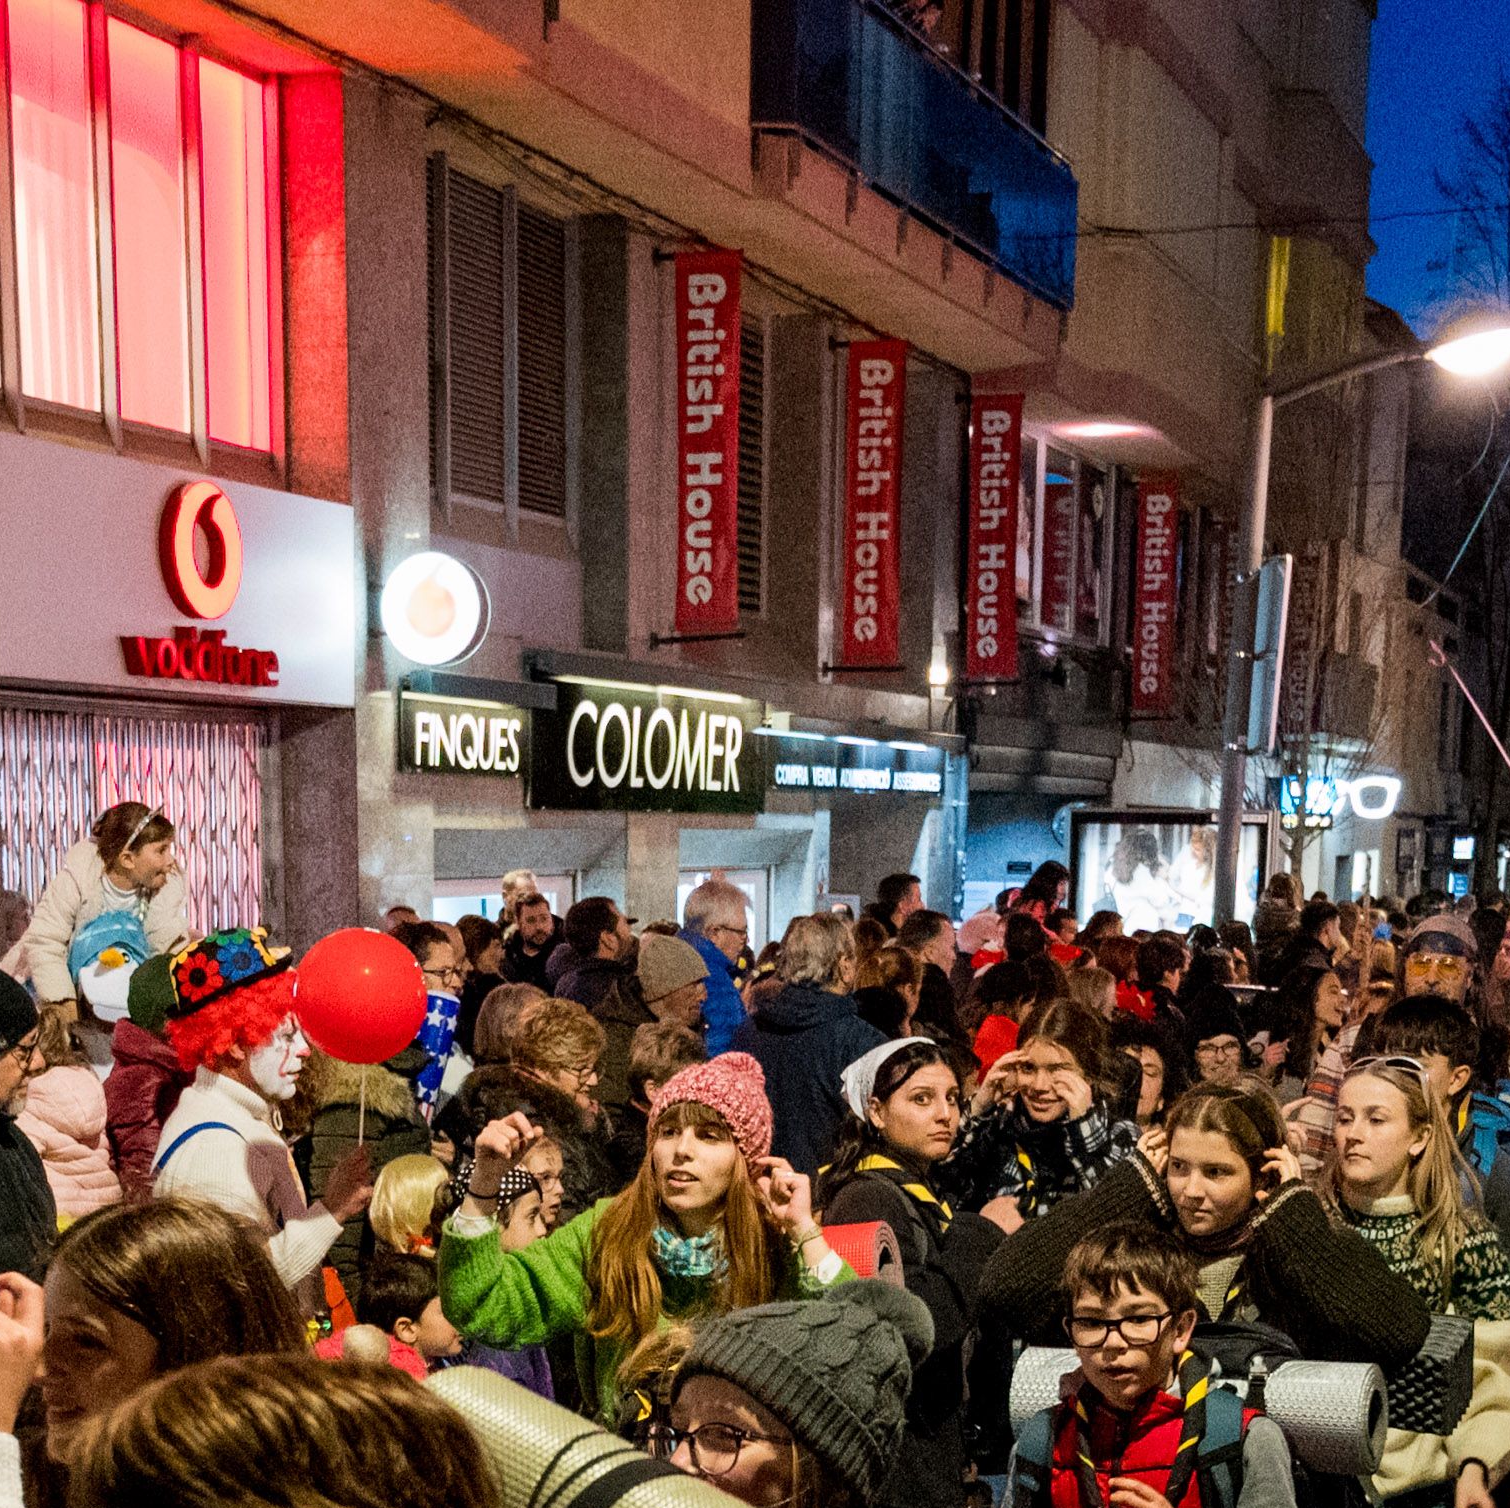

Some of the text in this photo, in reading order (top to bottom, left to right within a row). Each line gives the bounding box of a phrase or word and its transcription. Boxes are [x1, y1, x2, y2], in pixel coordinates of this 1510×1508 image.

[685, 272, 727, 607] British House
[854, 358, 894, 643] British House
[975, 409, 1012, 659] British House
[118, 625, 279, 687] vodafone
[1139, 493, 1173, 695] British House
[415, 700, 742, 792] FINQUES COLOMER
